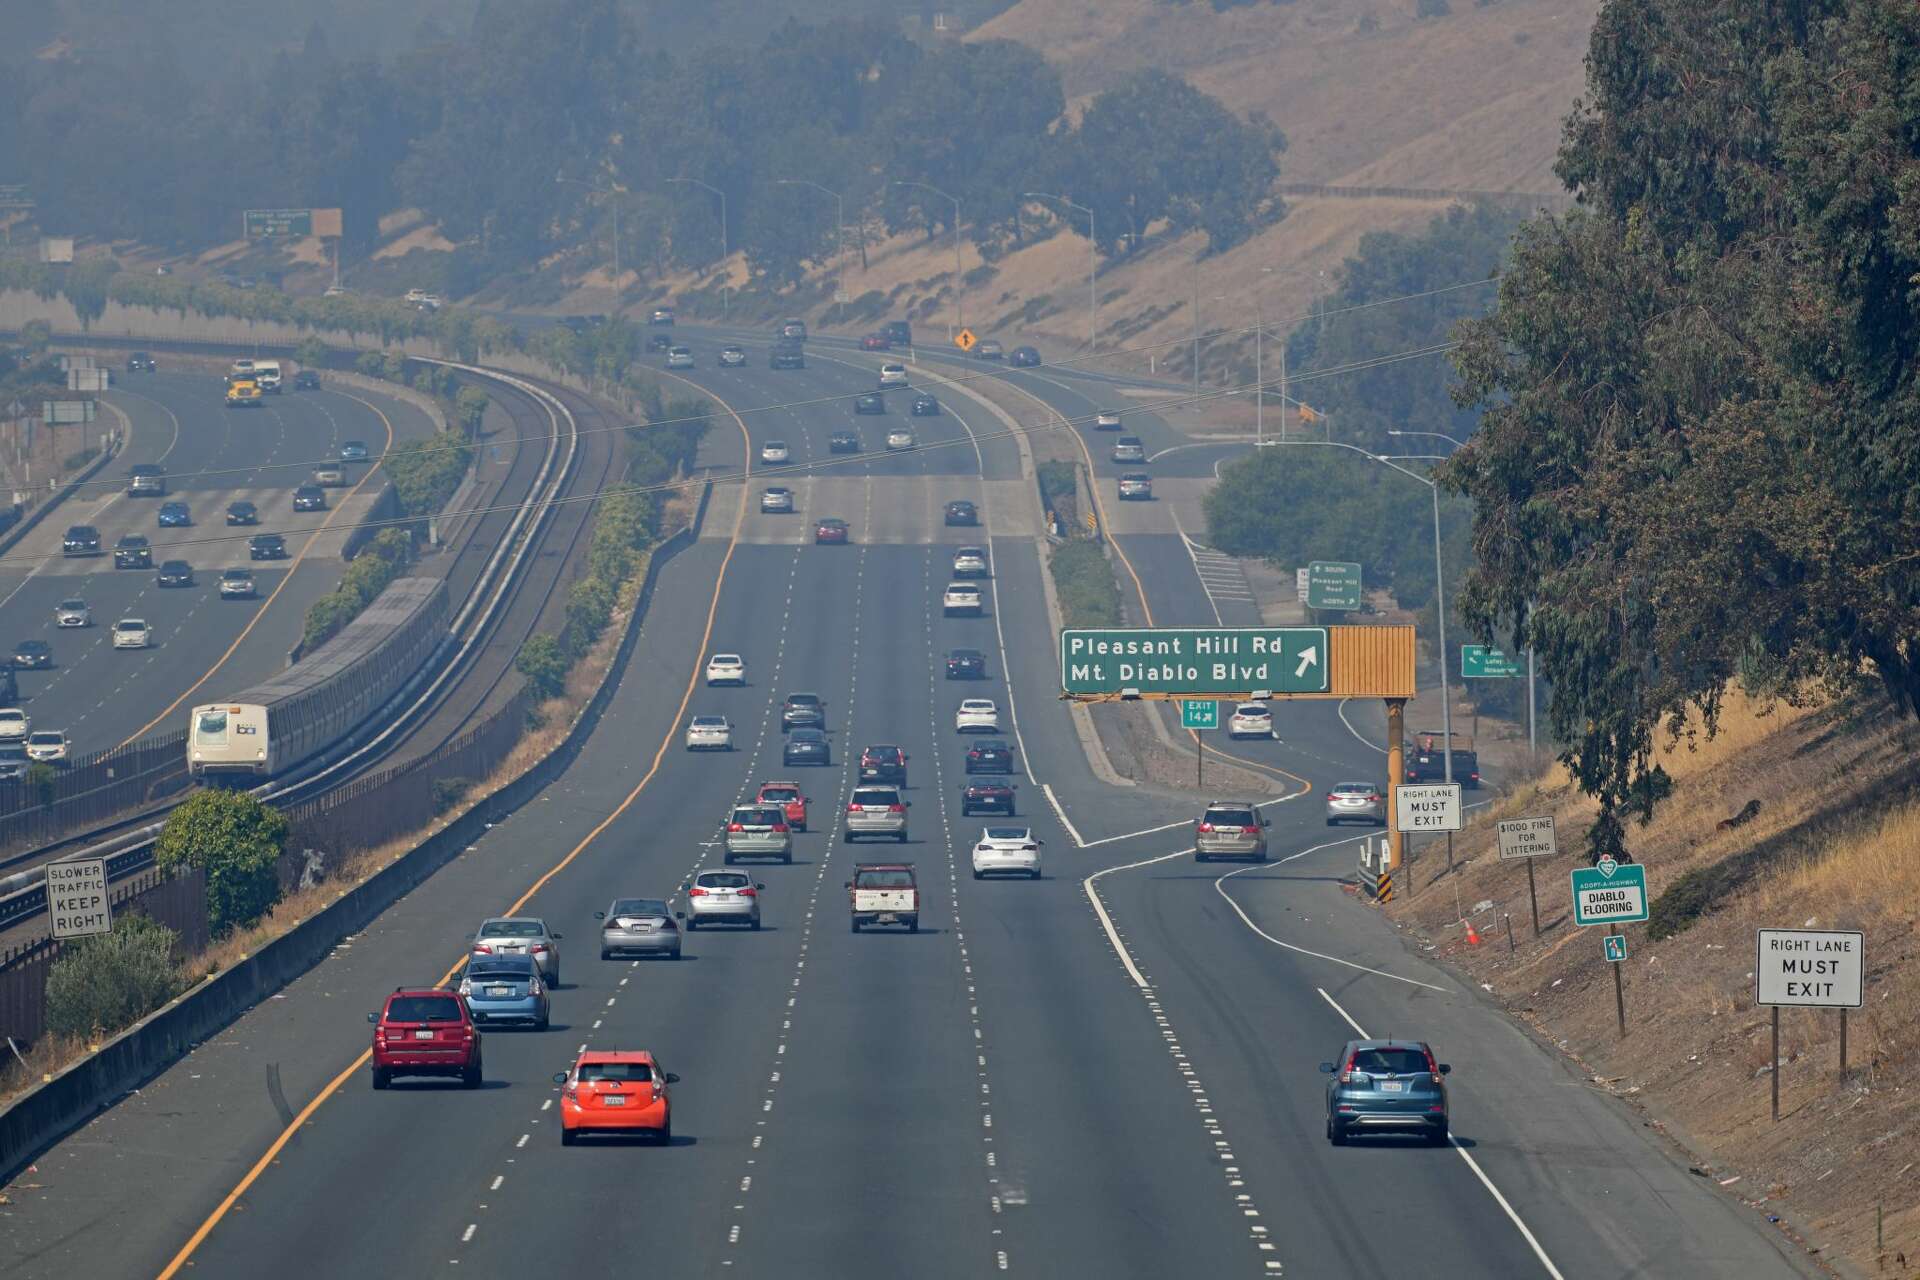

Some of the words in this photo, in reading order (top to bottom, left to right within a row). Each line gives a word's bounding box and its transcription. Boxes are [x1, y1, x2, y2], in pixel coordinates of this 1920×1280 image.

[1071, 637, 1181, 655] Pleasant
[1196, 637, 1239, 654] Hill
[1252, 637, 1283, 653] Rd
[1071, 664, 1106, 680] Mt.
[1120, 664, 1198, 681] Diablo
[1213, 663, 1268, 680] Blvd
[1188, 701, 1212, 710] EXIT
[1189, 711, 1201, 721] 14
[1403, 791, 1428, 799] RIGHT
[1431, 789, 1453, 798] LANE
[1411, 802, 1447, 812] MUST
[1414, 816, 1444, 826] EXIT
[1501, 823, 1528, 832] $1000
[1532, 820, 1552, 829] FINE
[1518, 833, 1536, 842] FOR
[1506, 843, 1550, 855] LITTERING
[51, 866, 100, 879] SLOWER
[51, 880, 103, 893] TRAFFIC
[1579, 879, 1638, 889] ADOPT-A-HIGHWAY
[1589, 891, 1625, 903] DIABLO
[57, 896, 100, 911] KEEP
[1584, 902, 1633, 915] FLOORING
[57, 914, 104, 929] RIGHT
[1771, 940, 1811, 951] RIGHT
[1816, 941, 1852, 952] LANE
[1782, 959, 1839, 974] MUST
[1787, 982, 1834, 997] EXIT
